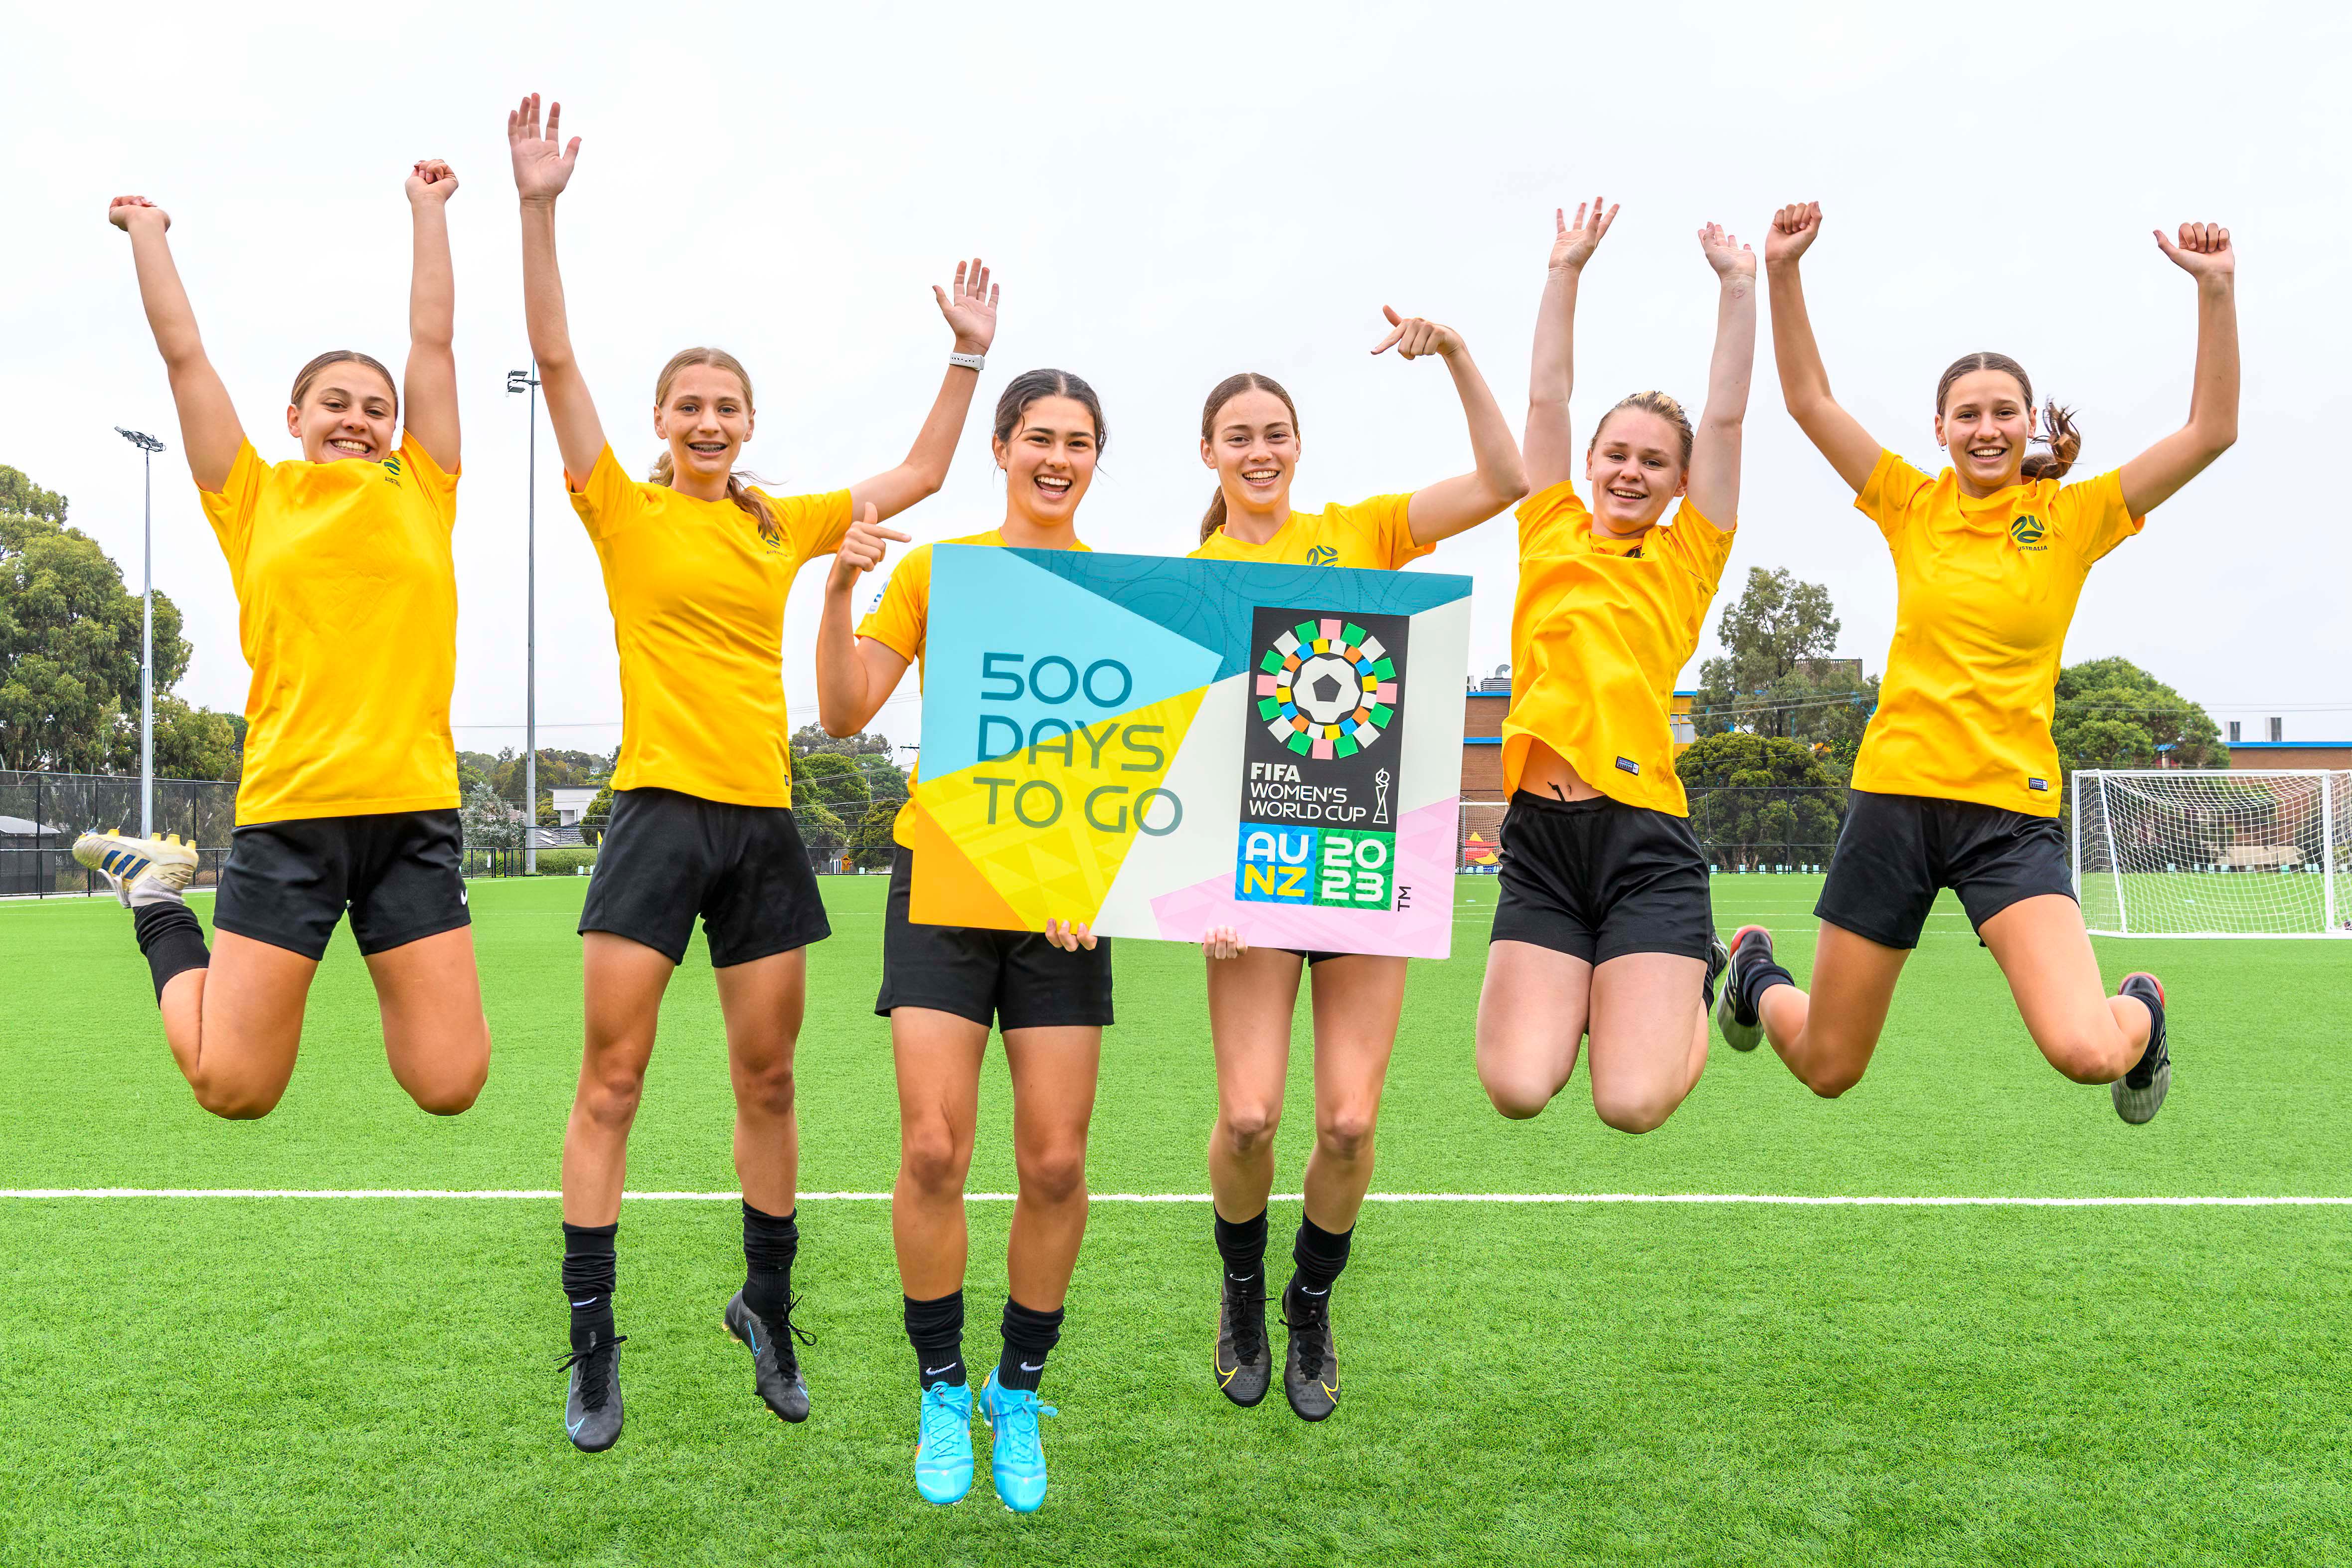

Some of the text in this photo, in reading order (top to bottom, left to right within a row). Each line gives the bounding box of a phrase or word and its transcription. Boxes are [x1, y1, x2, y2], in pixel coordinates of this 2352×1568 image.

[981, 652, 1132, 708] 500
[977, 714, 1165, 772] DAYS
[1250, 762, 1301, 783] FIFA
[973, 777, 1183, 837] TO GO
[1250, 782, 1347, 803] WOMEN'S
[1249, 800, 1366, 822] WORLD CUP
[1245, 831, 1309, 864] AU
[1324, 836, 1387, 870] 20
[1243, 864, 1307, 897] NZ
[1322, 869, 1384, 902] 23
[1397, 886, 1411, 912] TM
